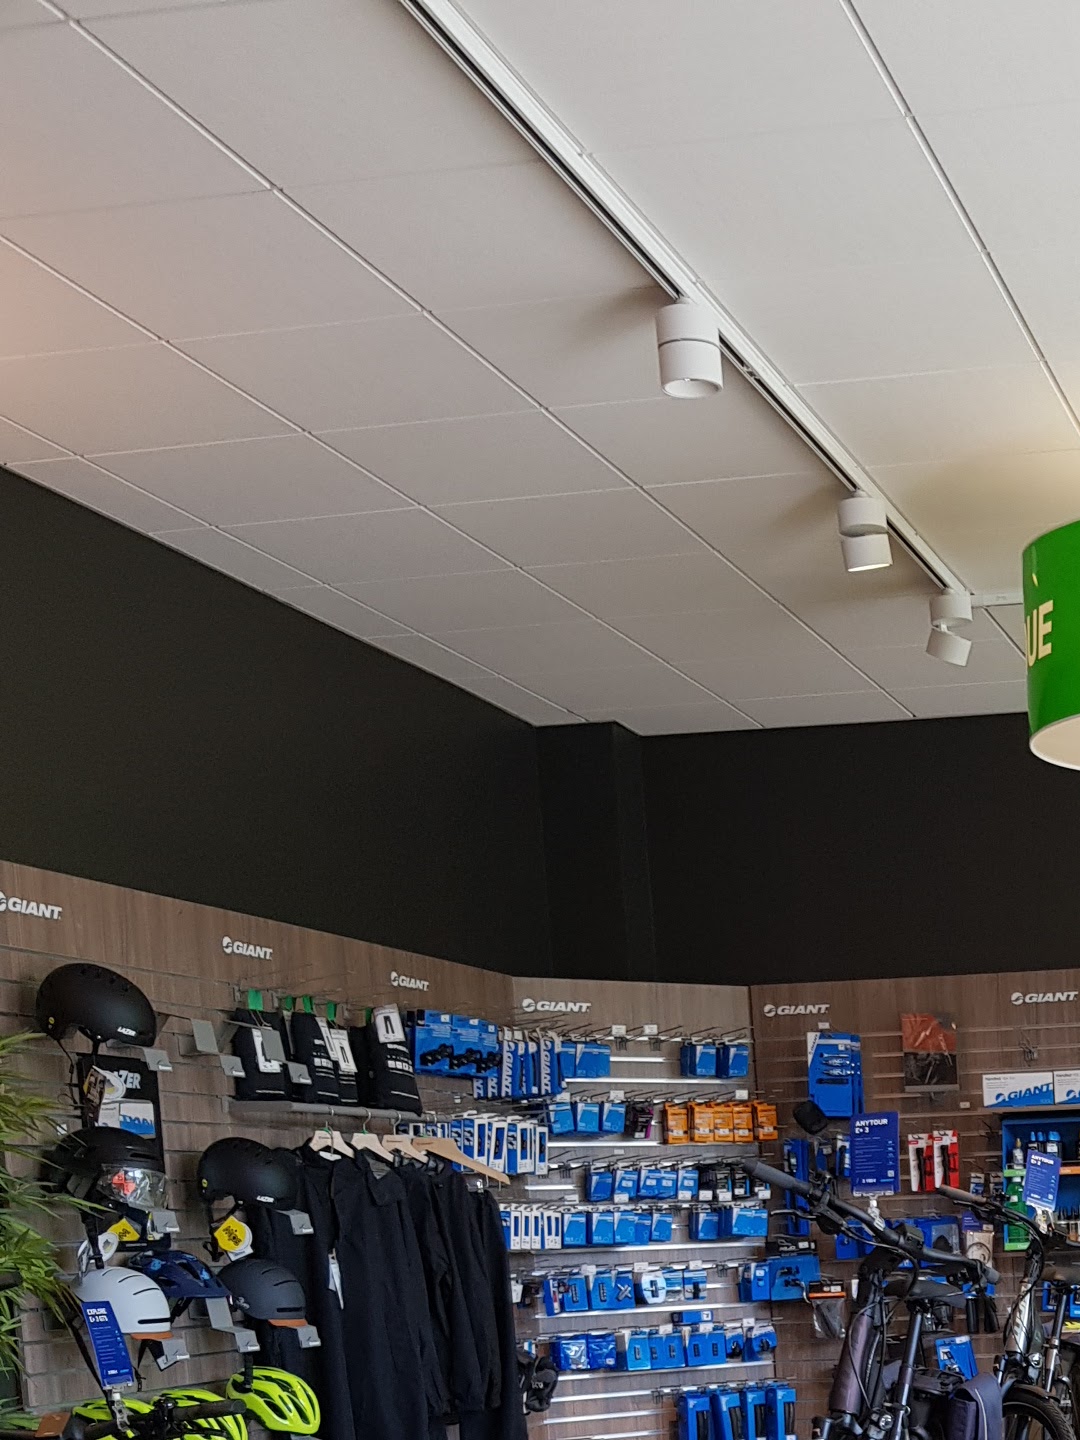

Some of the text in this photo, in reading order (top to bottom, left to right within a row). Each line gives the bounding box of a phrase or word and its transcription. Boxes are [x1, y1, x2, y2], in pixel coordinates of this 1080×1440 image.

[8, 897, 62, 920] GIANT
[233, 942, 273, 960] GIANT
[399, 974, 430, 991] GIANT
[1024, 991, 1079, 1004] GIANT
[537, 1001, 592, 1014] GIANT
[777, 1004, 830, 1016] GIANT
[1008, 1082, 1053, 1101] GIANT
[855, 1119, 888, 1127] ANYTOUR
